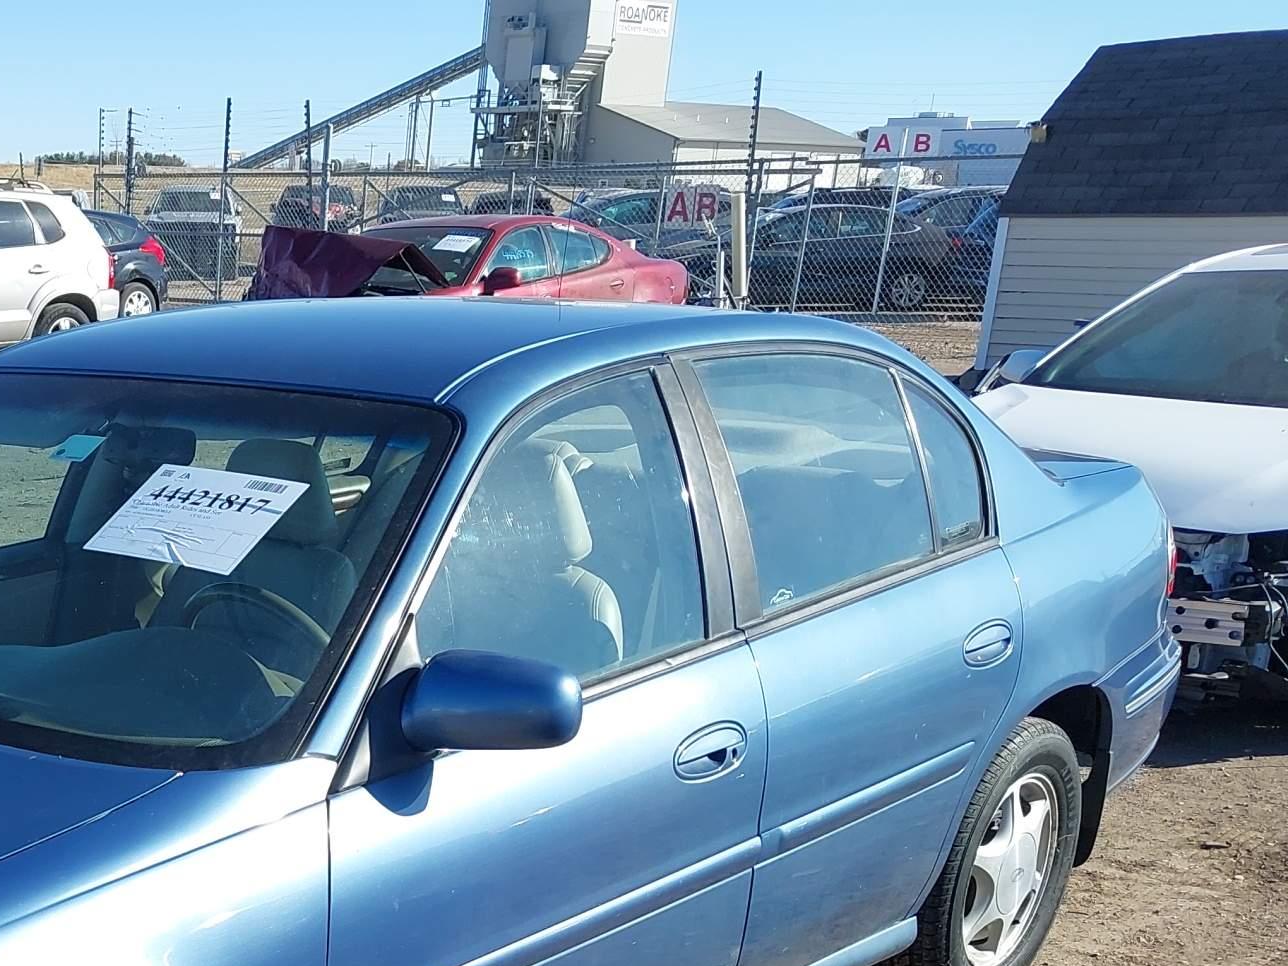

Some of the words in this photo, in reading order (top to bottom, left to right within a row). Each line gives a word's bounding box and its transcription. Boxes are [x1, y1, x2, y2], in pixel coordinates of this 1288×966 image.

[619, 6, 669, 23] ROANOKE
[873, 134, 891, 152] A
[914, 134, 931, 152] B
[953, 139, 997, 155] Sysco
[667, 191, 689, 222] A
[695, 192, 717, 222] B
[148, 485, 272, 515] 44421817
